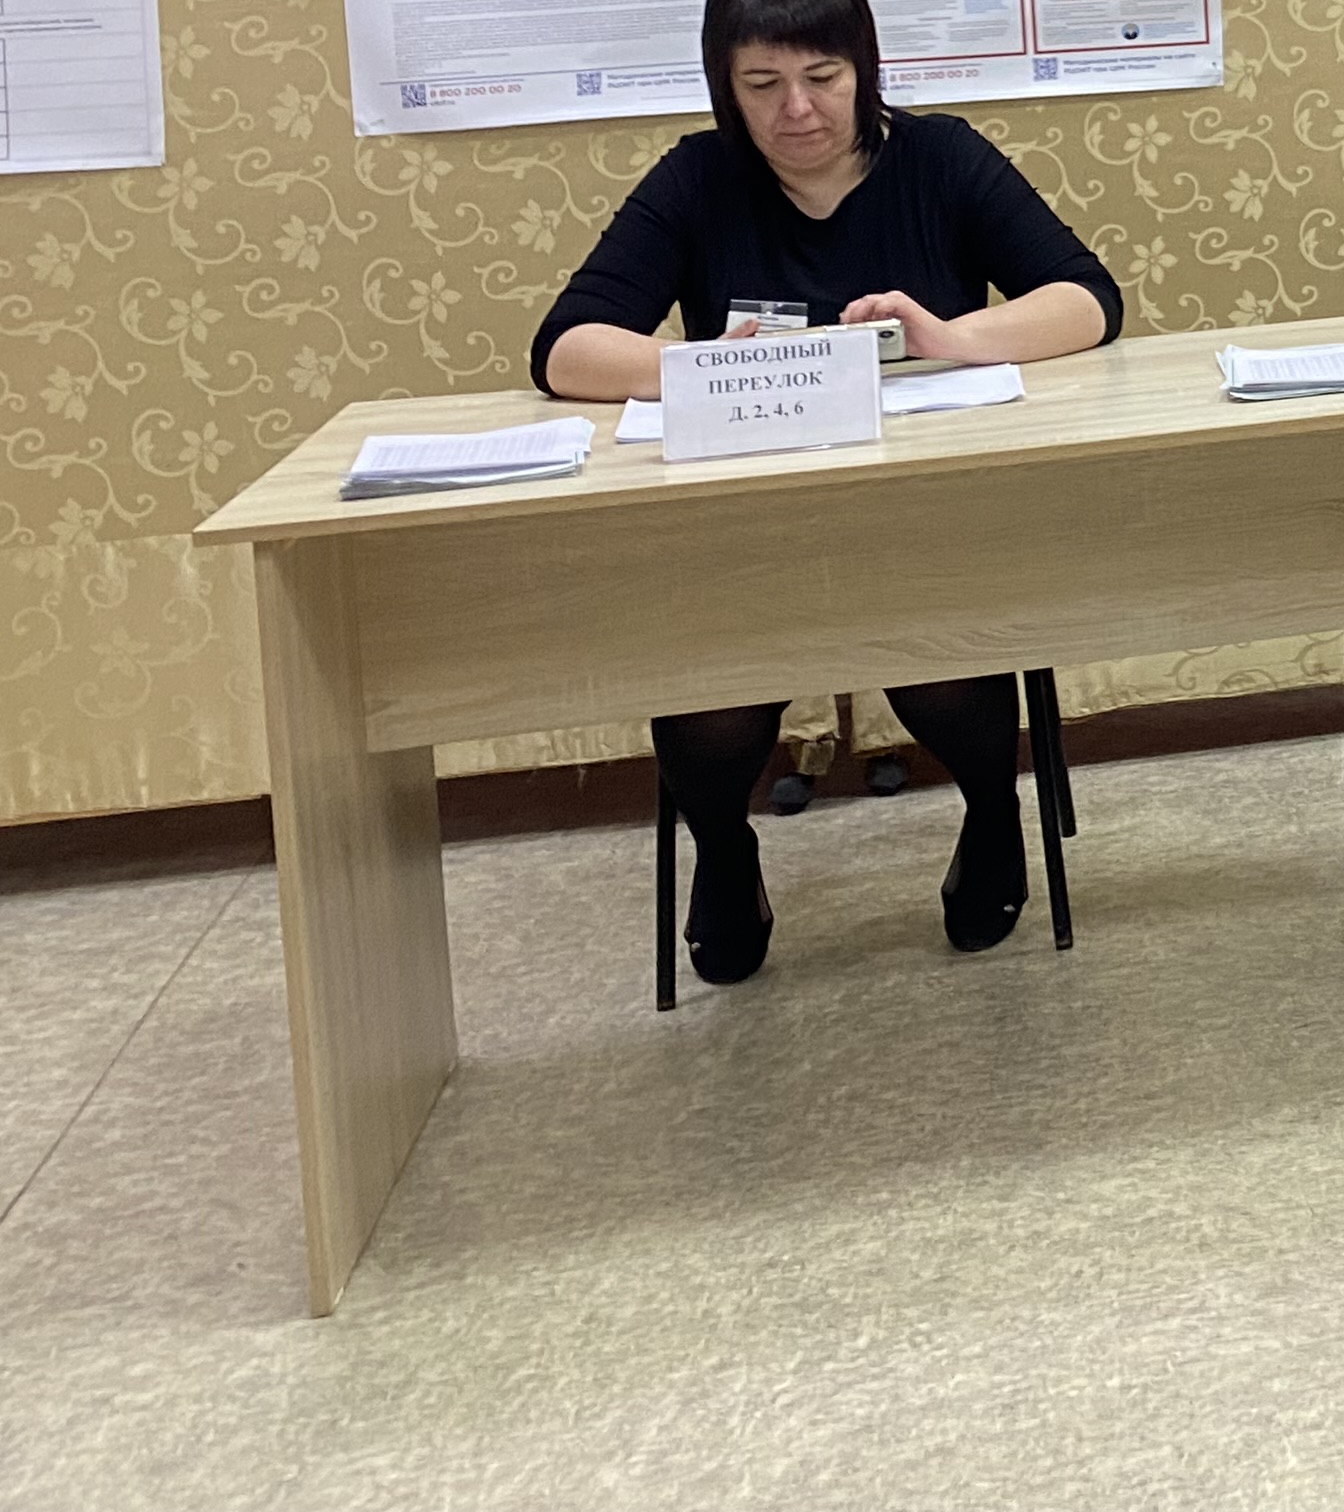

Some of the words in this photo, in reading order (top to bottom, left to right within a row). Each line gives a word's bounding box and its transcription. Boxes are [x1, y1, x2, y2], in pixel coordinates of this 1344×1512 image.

[695, 339, 832, 368] СВОБОДНЫЙ
[709, 371, 823, 394] ПЕРЕУЛОК
[728, 406, 748, 423] Д.
[794, 400, 804, 415] 6
